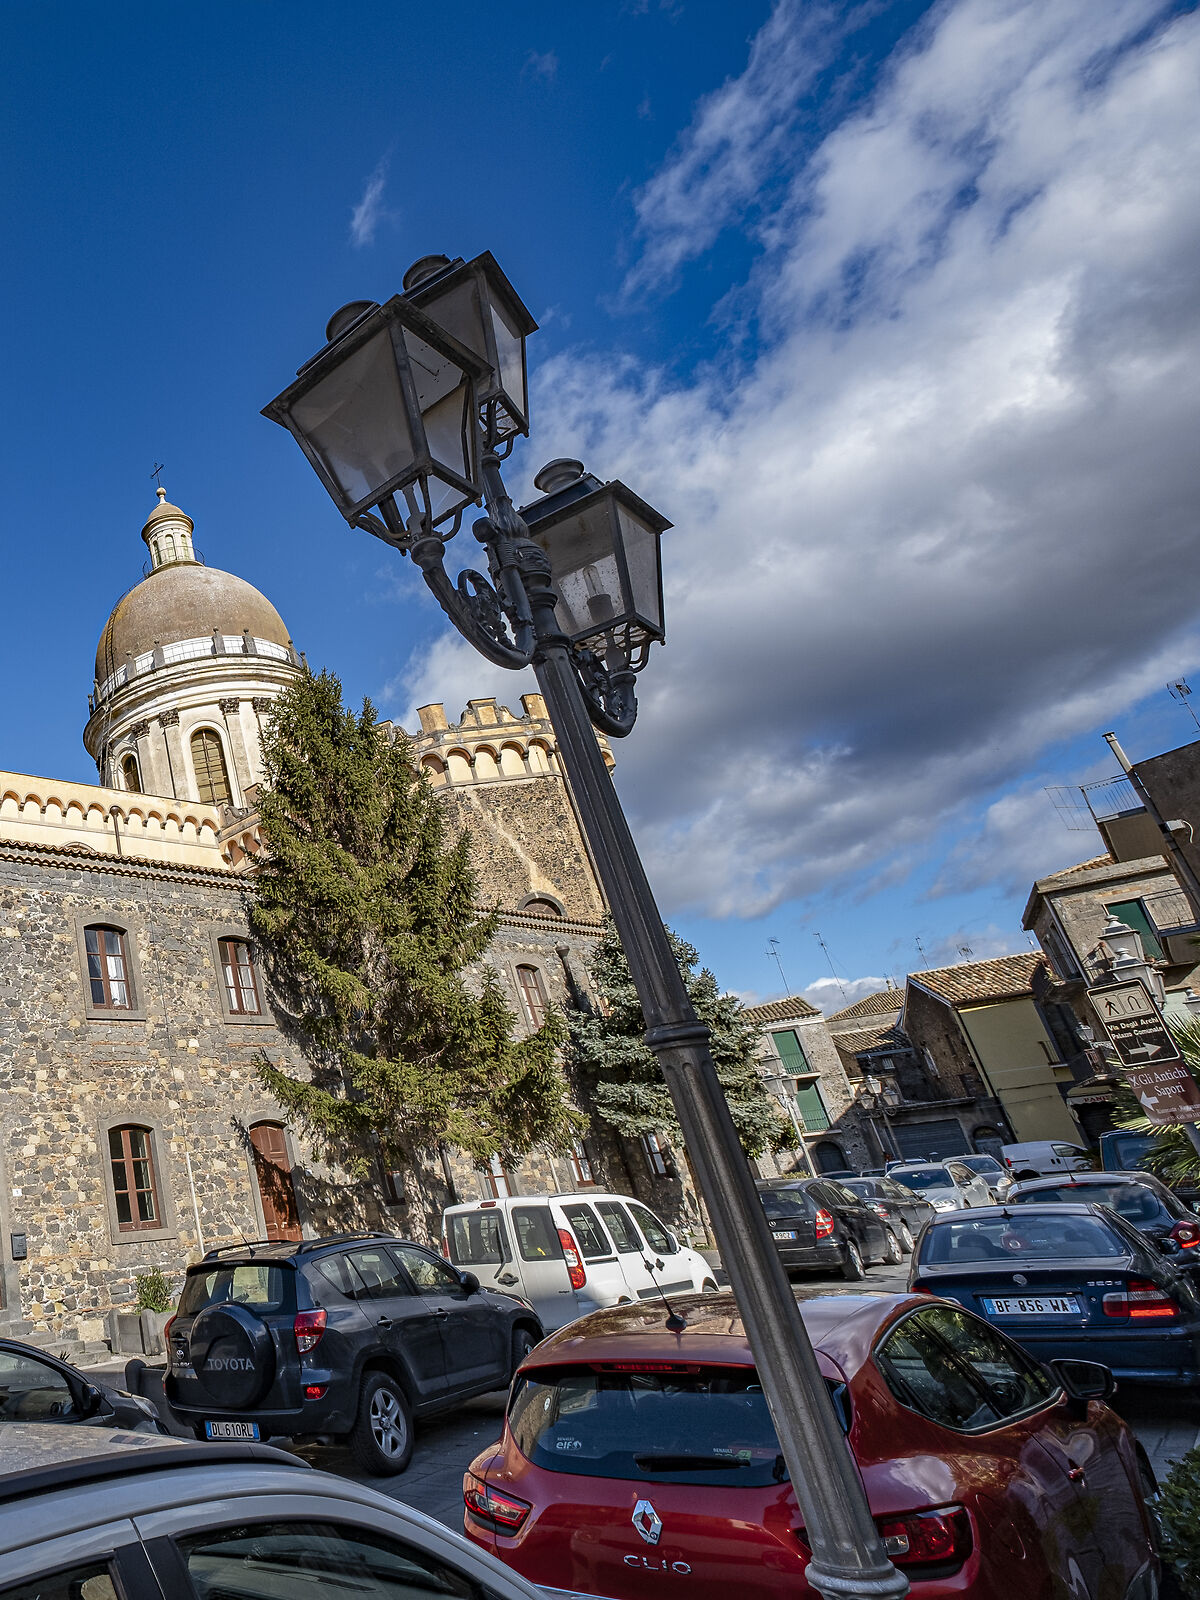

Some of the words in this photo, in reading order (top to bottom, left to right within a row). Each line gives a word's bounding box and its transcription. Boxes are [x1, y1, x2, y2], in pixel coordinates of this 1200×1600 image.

[1120, 1021, 1139, 1029] Degli
[1140, 1017, 1159, 1025] Archi
[1111, 1032, 1133, 1040] Palazzo
[1133, 1026, 1163, 1036] Comunale
[1138, 1073, 1154, 1085] Gli
[1154, 1066, 1189, 1083] Antichi
[1154, 1081, 1186, 1098] Sapori
[207, 1358, 255, 1371] TOYOTA
[212, 1422, 223, 1436] DL
[225, 1422, 253, 1437] 610RL
[556, 1441, 572, 1449] elf
[623, 1555, 693, 1575] CLIO
